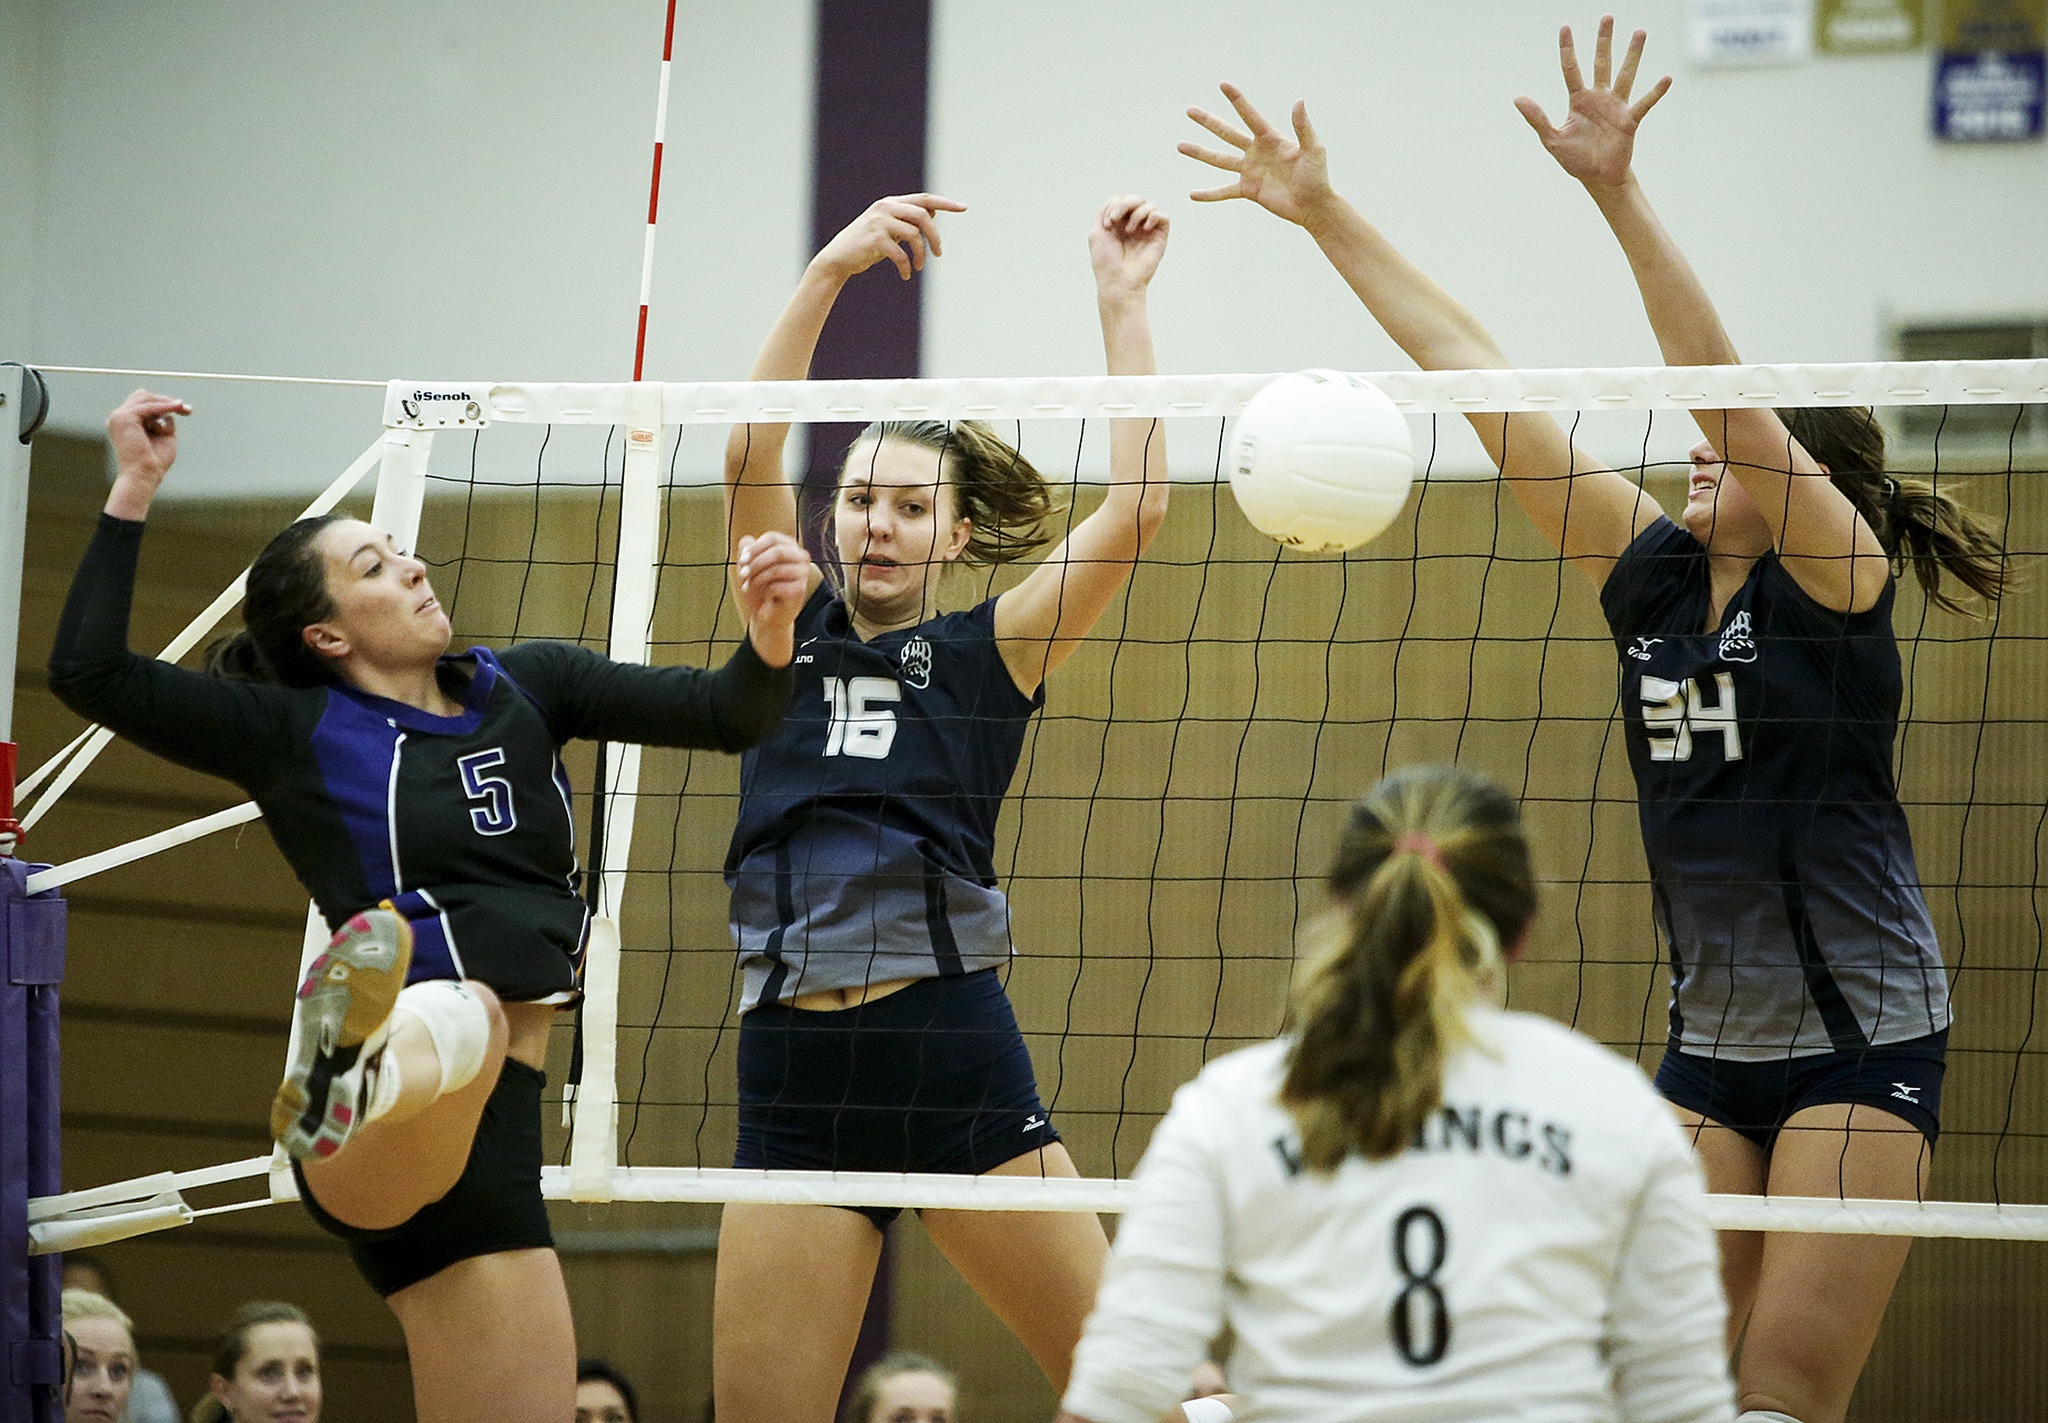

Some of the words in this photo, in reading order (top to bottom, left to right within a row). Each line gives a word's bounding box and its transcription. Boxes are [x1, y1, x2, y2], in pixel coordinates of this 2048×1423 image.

[423, 391, 471, 401] Senoh
[822, 676, 901, 760] 16
[1640, 671, 1743, 762] 34
[457, 747, 517, 836] 5
[1391, 1204, 1448, 1369] 8
